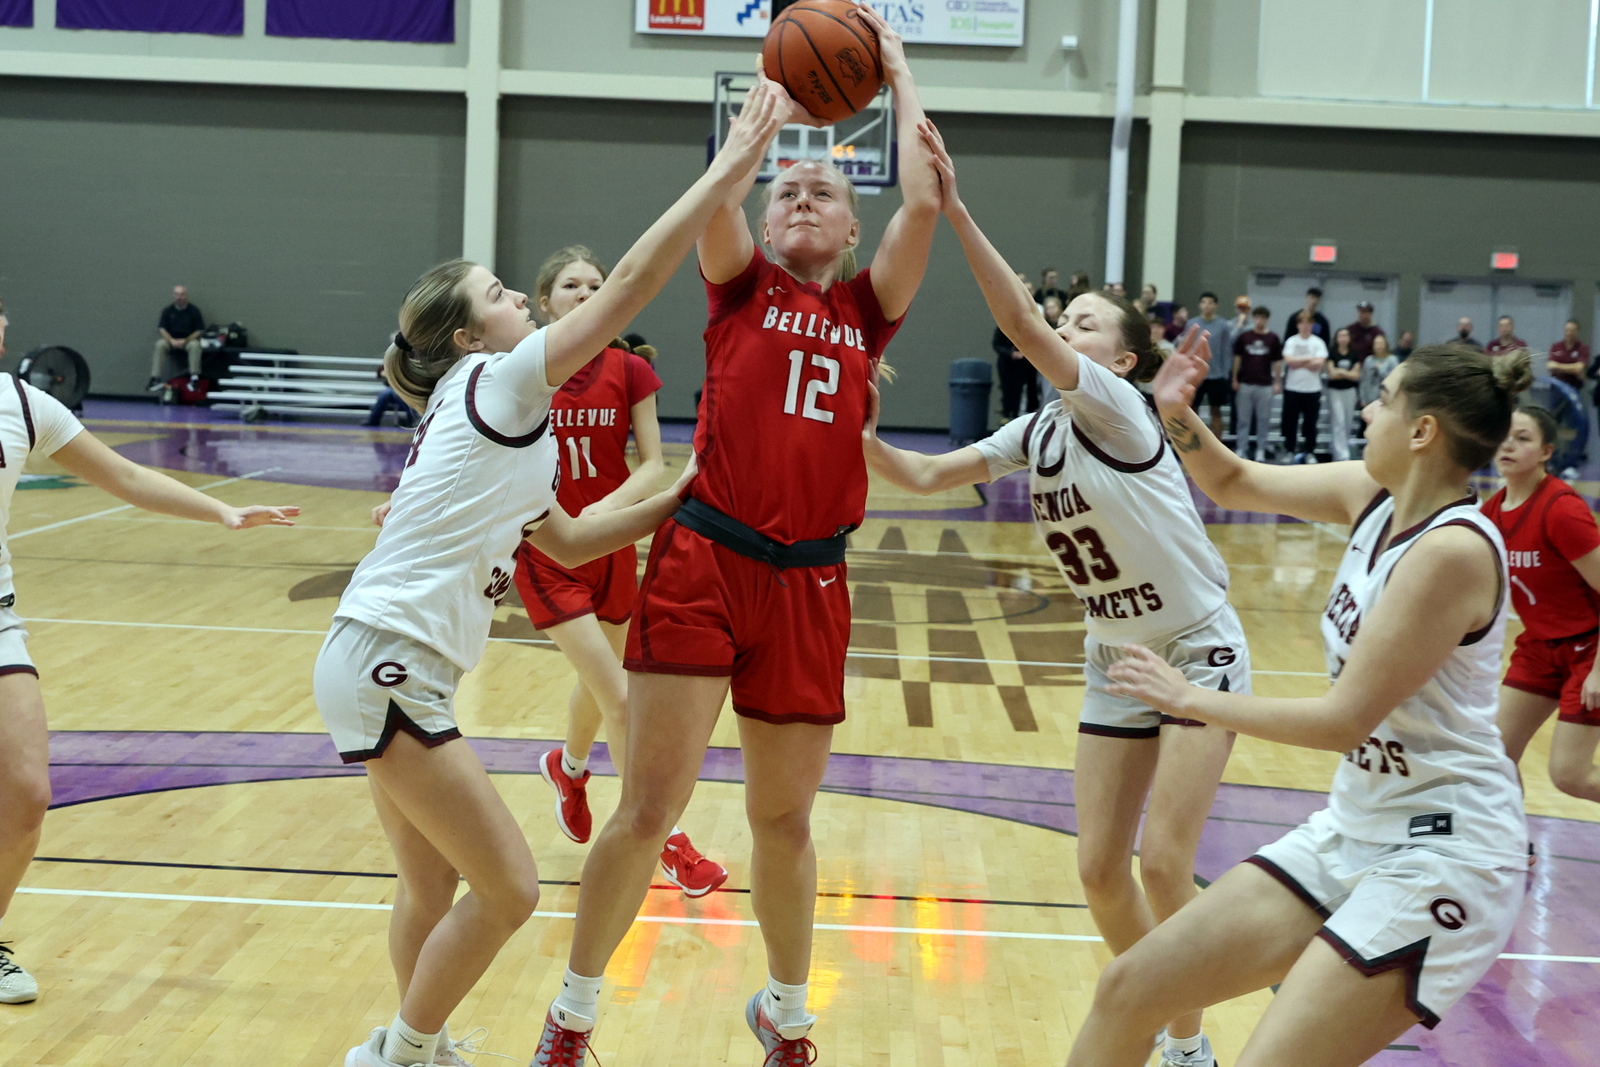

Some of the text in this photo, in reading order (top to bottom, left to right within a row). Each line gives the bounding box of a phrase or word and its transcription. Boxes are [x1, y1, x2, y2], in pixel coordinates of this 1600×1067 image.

[675, 15, 703, 26] Family
[762, 305, 866, 352] BELLEVUE
[783, 349, 840, 424] 12
[548, 408, 617, 427] ELLEVUE
[565, 436, 598, 480] 11
[1032, 483, 1092, 522] ENOA
[1046, 525, 1120, 586] 33
[1080, 582, 1163, 619] METS
[371, 660, 409, 688] G
[1207, 646, 1236, 668] G
[1430, 897, 1466, 931] G
